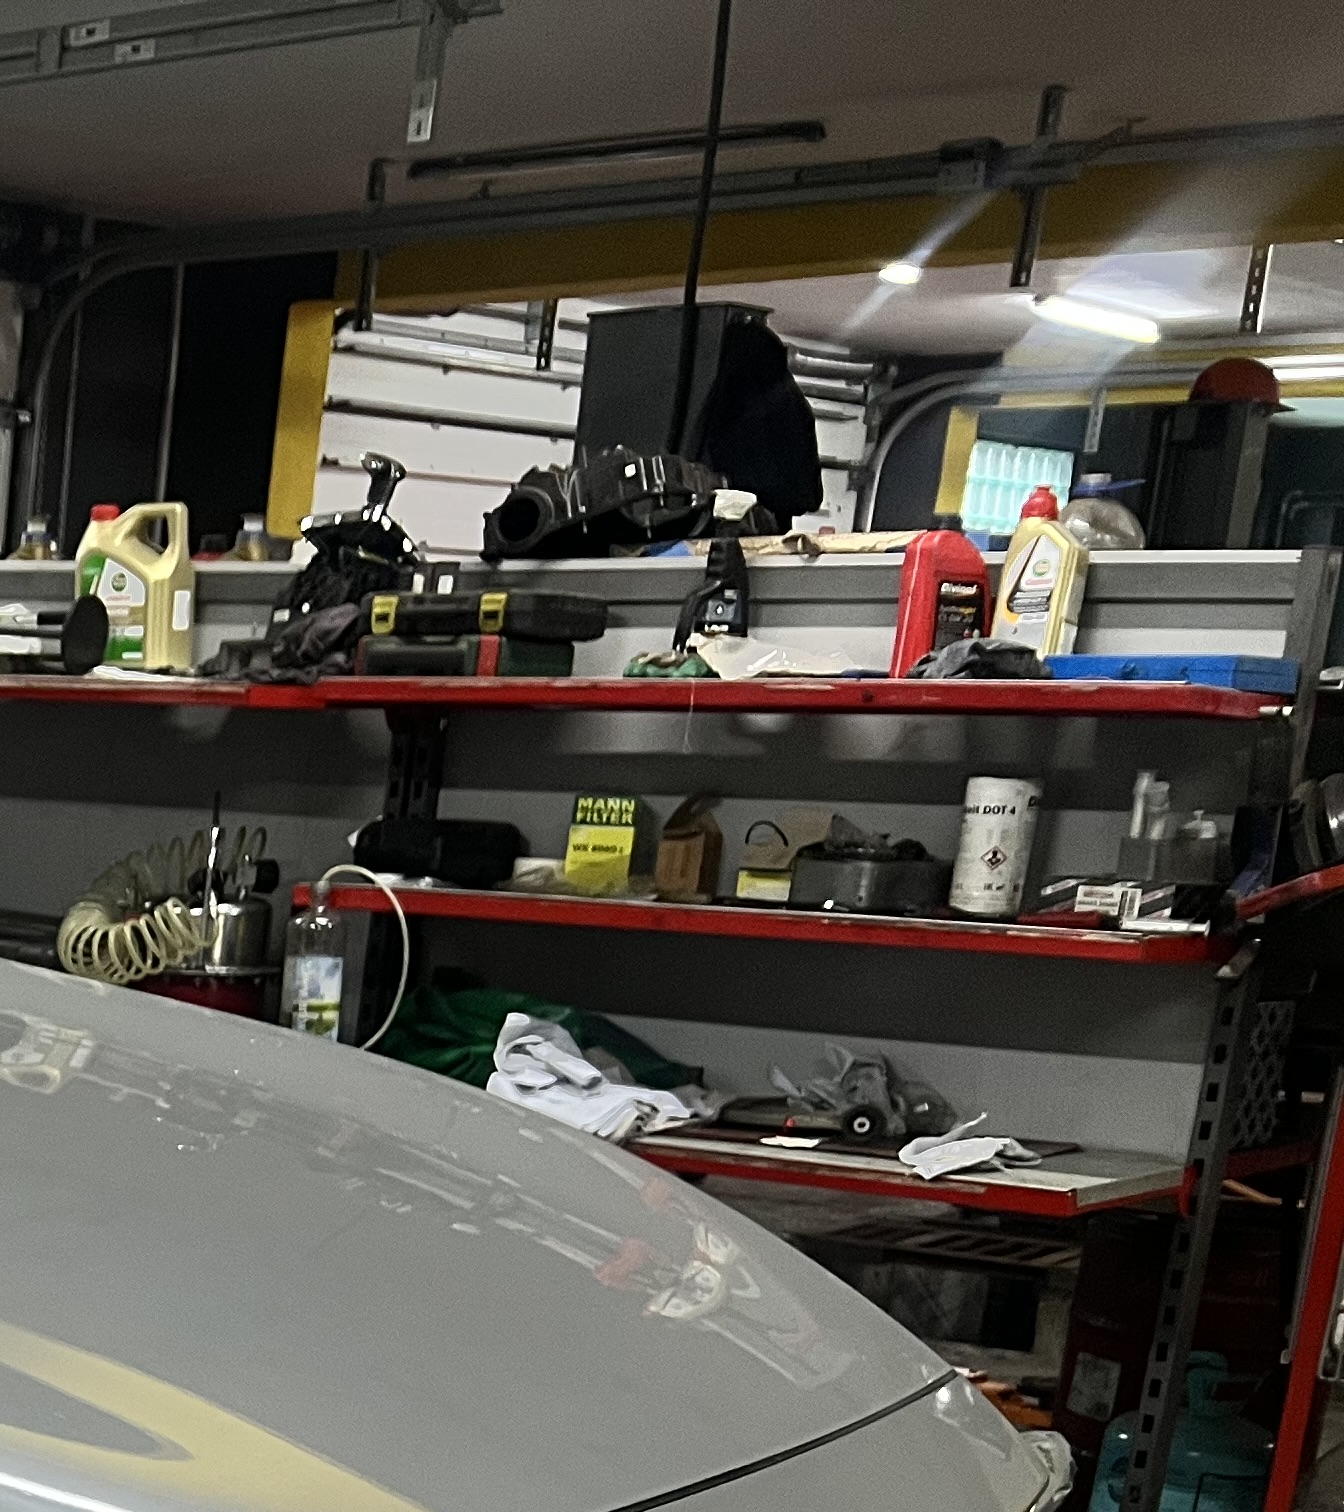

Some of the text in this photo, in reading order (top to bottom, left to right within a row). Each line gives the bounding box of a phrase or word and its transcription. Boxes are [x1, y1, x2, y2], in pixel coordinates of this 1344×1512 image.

[578, 797, 635, 811] MANN
[982, 804, 1008, 815] DOT
[1009, 804, 1017, 815] 4
[576, 811, 633, 825] FILTER
